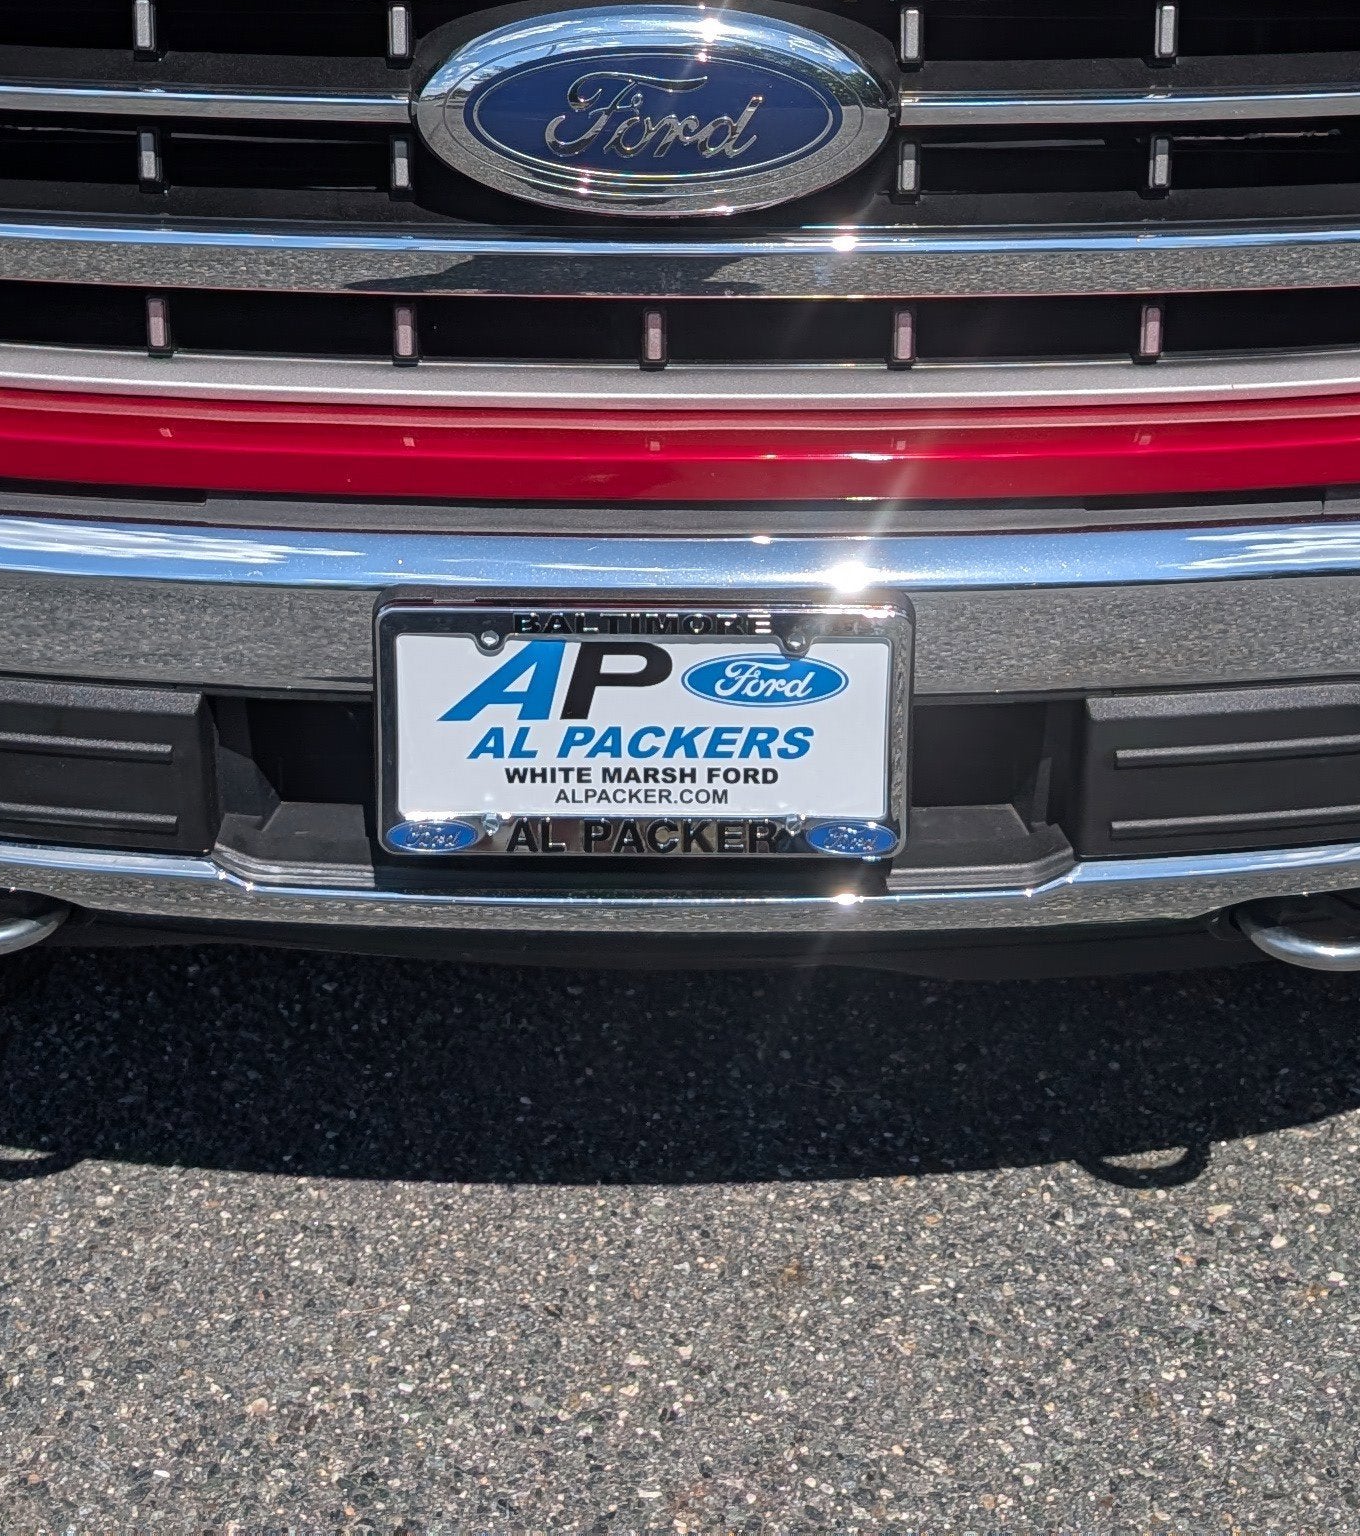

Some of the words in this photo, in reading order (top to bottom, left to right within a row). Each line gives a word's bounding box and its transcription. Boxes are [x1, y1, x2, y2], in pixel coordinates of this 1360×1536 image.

[545, 71, 764, 158] Ford
[513, 613, 771, 634] BALTIMORE
[437, 640, 673, 721] AP
[714, 661, 814, 698] Ford
[466, 727, 541, 760] AL
[556, 726, 814, 760] PACKERS
[505, 767, 593, 785] WHITE
[601, 767, 697, 785] MARSH
[707, 767, 779, 785] FORD
[554, 788, 729, 805] ALPACKER.COM
[505, 820, 565, 853] AL
[583, 819, 777, 853] PACKER
